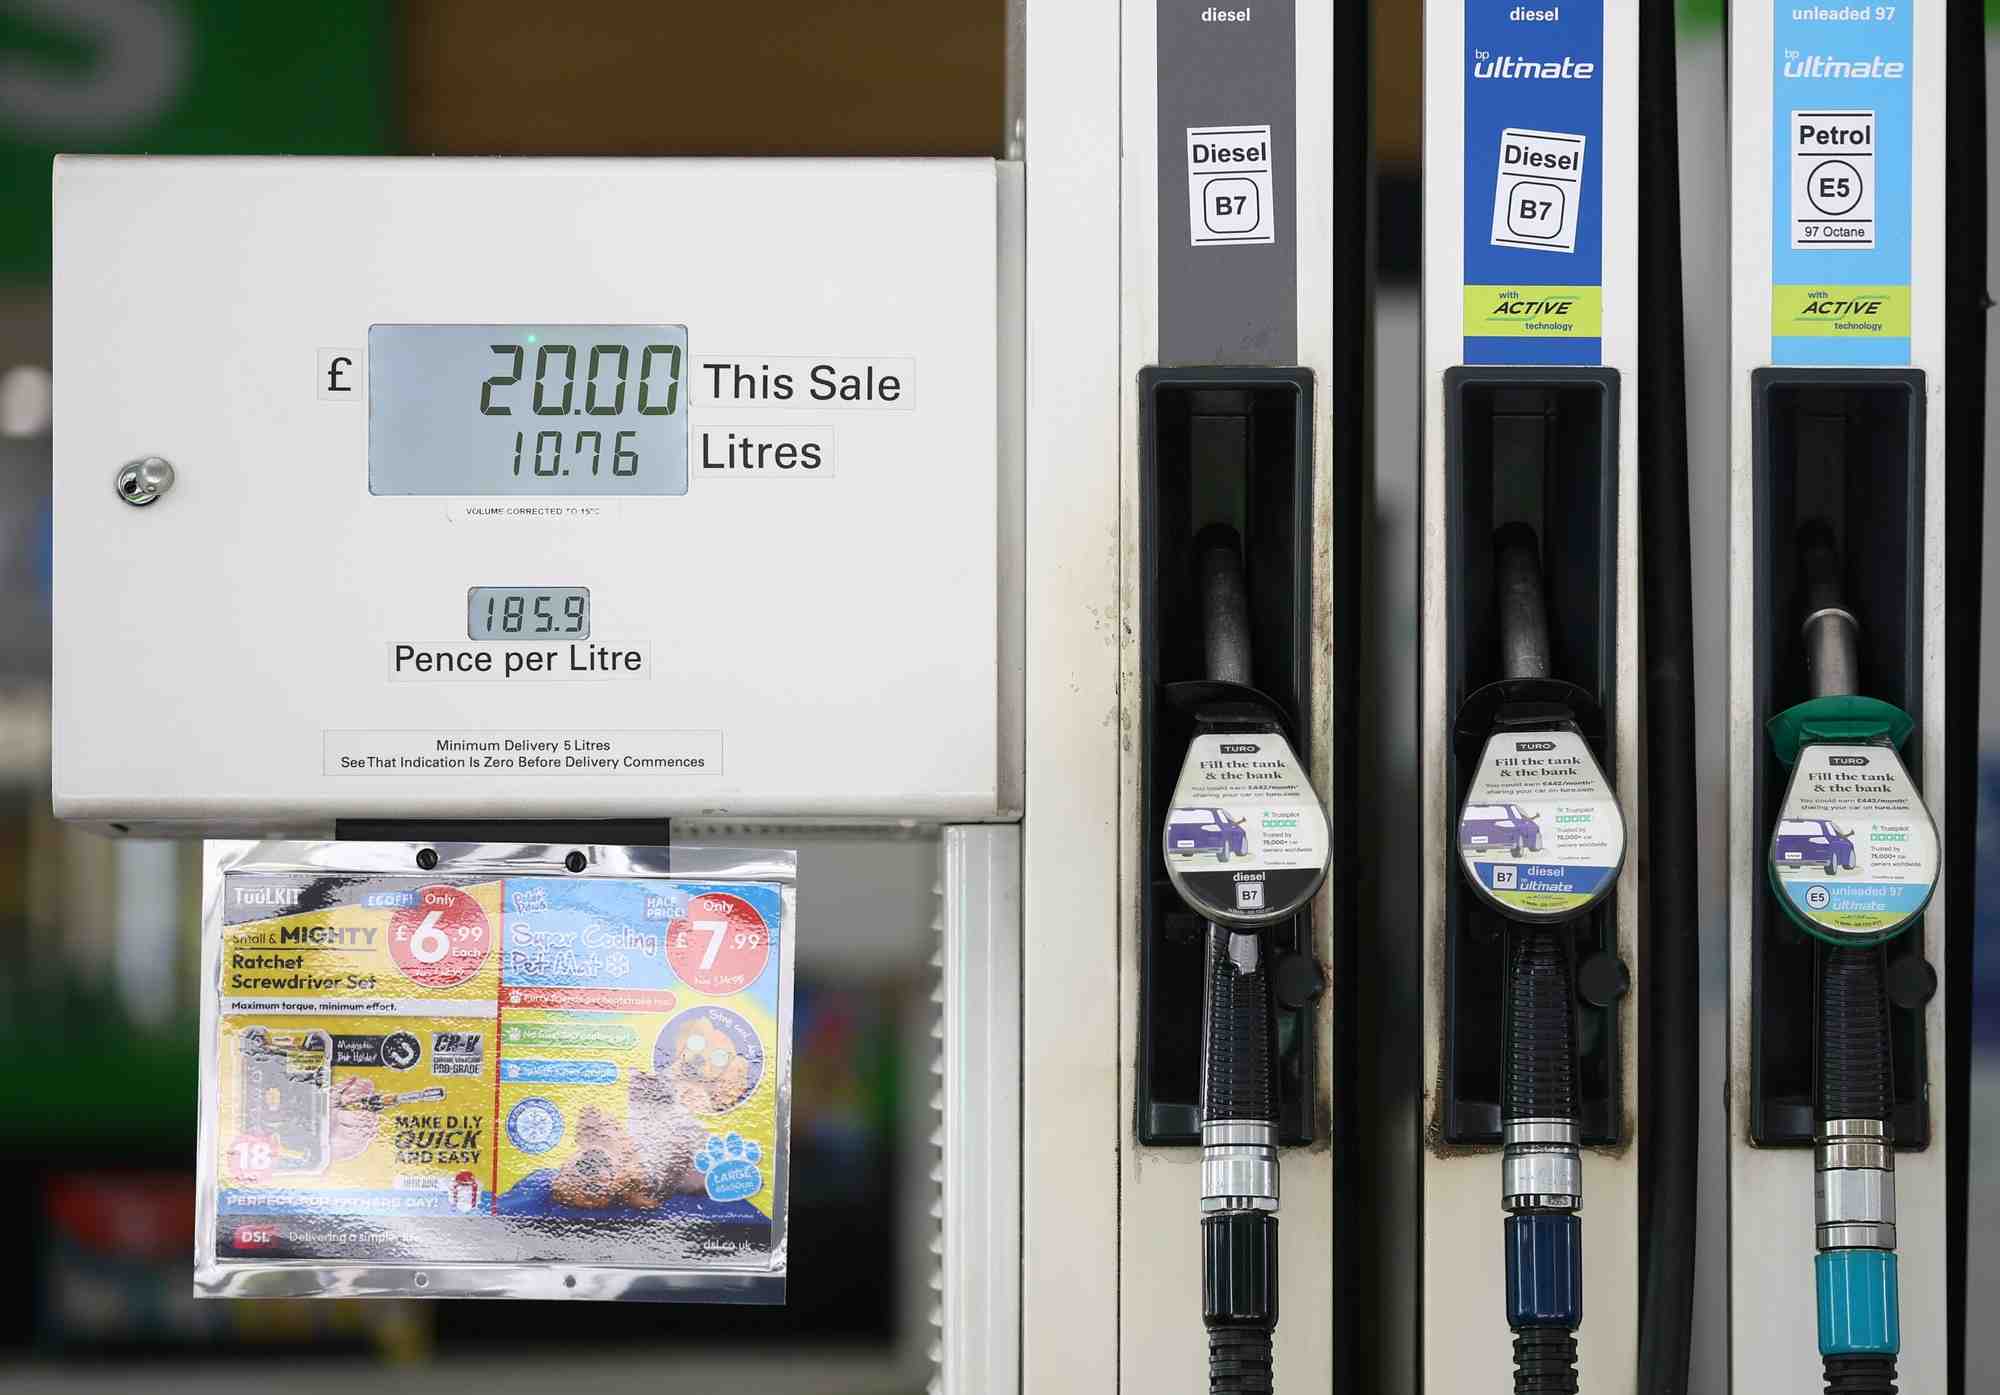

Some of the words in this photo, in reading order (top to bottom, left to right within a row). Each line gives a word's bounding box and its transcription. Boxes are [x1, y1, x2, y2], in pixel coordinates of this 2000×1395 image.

[1201, 8, 1250, 22] diesel
[1509, 8, 1559, 21] diesel
[1792, 8, 1873, 21] unleaded
[1875, 8, 1896, 21] 97
[1475, 50, 1489, 61] bp
[1784, 49, 1799, 60] bp
[1475, 56, 1593, 80] ultimate
[1783, 56, 1904, 79] ultimate
[1800, 125, 1871, 145] Petrol
[1192, 142, 1267, 164] Diesel
[1504, 145, 1579, 172] Diesel
[1820, 178, 1850, 198] E5
[1215, 196, 1247, 216] B7
[1520, 200, 1552, 222] B7
[1805, 226, 1819, 237] 97
[1823, 226, 1865, 238] Octane
[1499, 291, 1519, 299] with
[1808, 291, 1829, 299] with
[1493, 301, 1573, 315] ACTIVE
[1802, 301, 1881, 315] ACTIVE
[1525, 322, 1573, 331] technology
[1834, 321, 1882, 331] technology
[327, 356, 352, 392] £
[480, 344, 682, 416] 20.00
[703, 363, 794, 400] This
[809, 365, 900, 401] Sale
[513, 431, 640, 476] 10.76
[702, 433, 822, 470] Litres
[487, 596, 585, 632] 185.9
[395, 645, 492, 671] Pence
[505, 650, 558, 678] per
[570, 645, 642, 671] Litre
[436, 740, 500, 751] Minimum
[504, 740, 558, 753] Delivery
[563, 740, 571, 751] 5
[574, 740, 610, 751] Litres
[1224, 745, 1255, 753] TURO
[341, 757, 366, 768] See
[367, 757, 396, 768] That
[400, 756, 465, 768] Indication
[469, 757, 480, 768] Is
[484, 757, 514, 768] Zero
[519, 756, 561, 768] Before
[565, 756, 620, 770] Delivery
[623, 757, 705, 768] Commences
[1200, 761, 1223, 769] Fill
[1226, 760, 1249, 768] the
[1252, 760, 1287, 768] tank
[1496, 758, 1517, 766] Fill
[1548, 757, 1580, 765] tank
[1205, 772, 1217, 780] &
[1246, 771, 1283, 780] bank
[1809, 773, 1831, 781] Fill
[1835, 772, 1858, 780] the
[1861, 773, 1895, 781] tank
[1829, 784, 1852, 792] the
[1855, 784, 1892, 792] bank
[1233, 871, 1265, 881] diesel
[1497, 873, 1512, 882] B7
[1528, 866, 1564, 877] diesel
[1520, 881, 1573, 891] ultimate
[1831, 886, 1886, 896] unleaded
[425, 893, 455, 908] Only
[1242, 890, 1257, 900] B7
[1811, 893, 1825, 902] E5
[704, 901, 734, 913] Only
[269, 933, 277, 944] &
[281, 927, 377, 945] MIGHTY
[512, 923, 576, 950] Super
[584, 924, 656, 956] Cooling
[452, 947, 481, 957] Each
[233, 955, 304, 970] Ratchet
[511, 951, 548, 973] Pet
[554, 952, 601, 976] Mat
[232, 975, 343, 989] Screwdriver
[347, 975, 377, 989] Set
[232, 1002, 280, 1010] Maximum
[282, 1001, 317, 1012] torque,
[319, 1002, 364, 1010] minimum
[366, 1003, 397, 1012] effort.
[395, 1116, 441, 1128] MAKE
[395, 1130, 481, 1149] QUICK
[396, 1151, 433, 1164] AND
[438, 1151, 480, 1164] EASY
[241, 1231, 270, 1243] DSL
[289, 1231, 346, 1244] Delivering
[348, 1233, 357, 1242] a
[703, 1239, 752, 1250] dsl.co.uk
